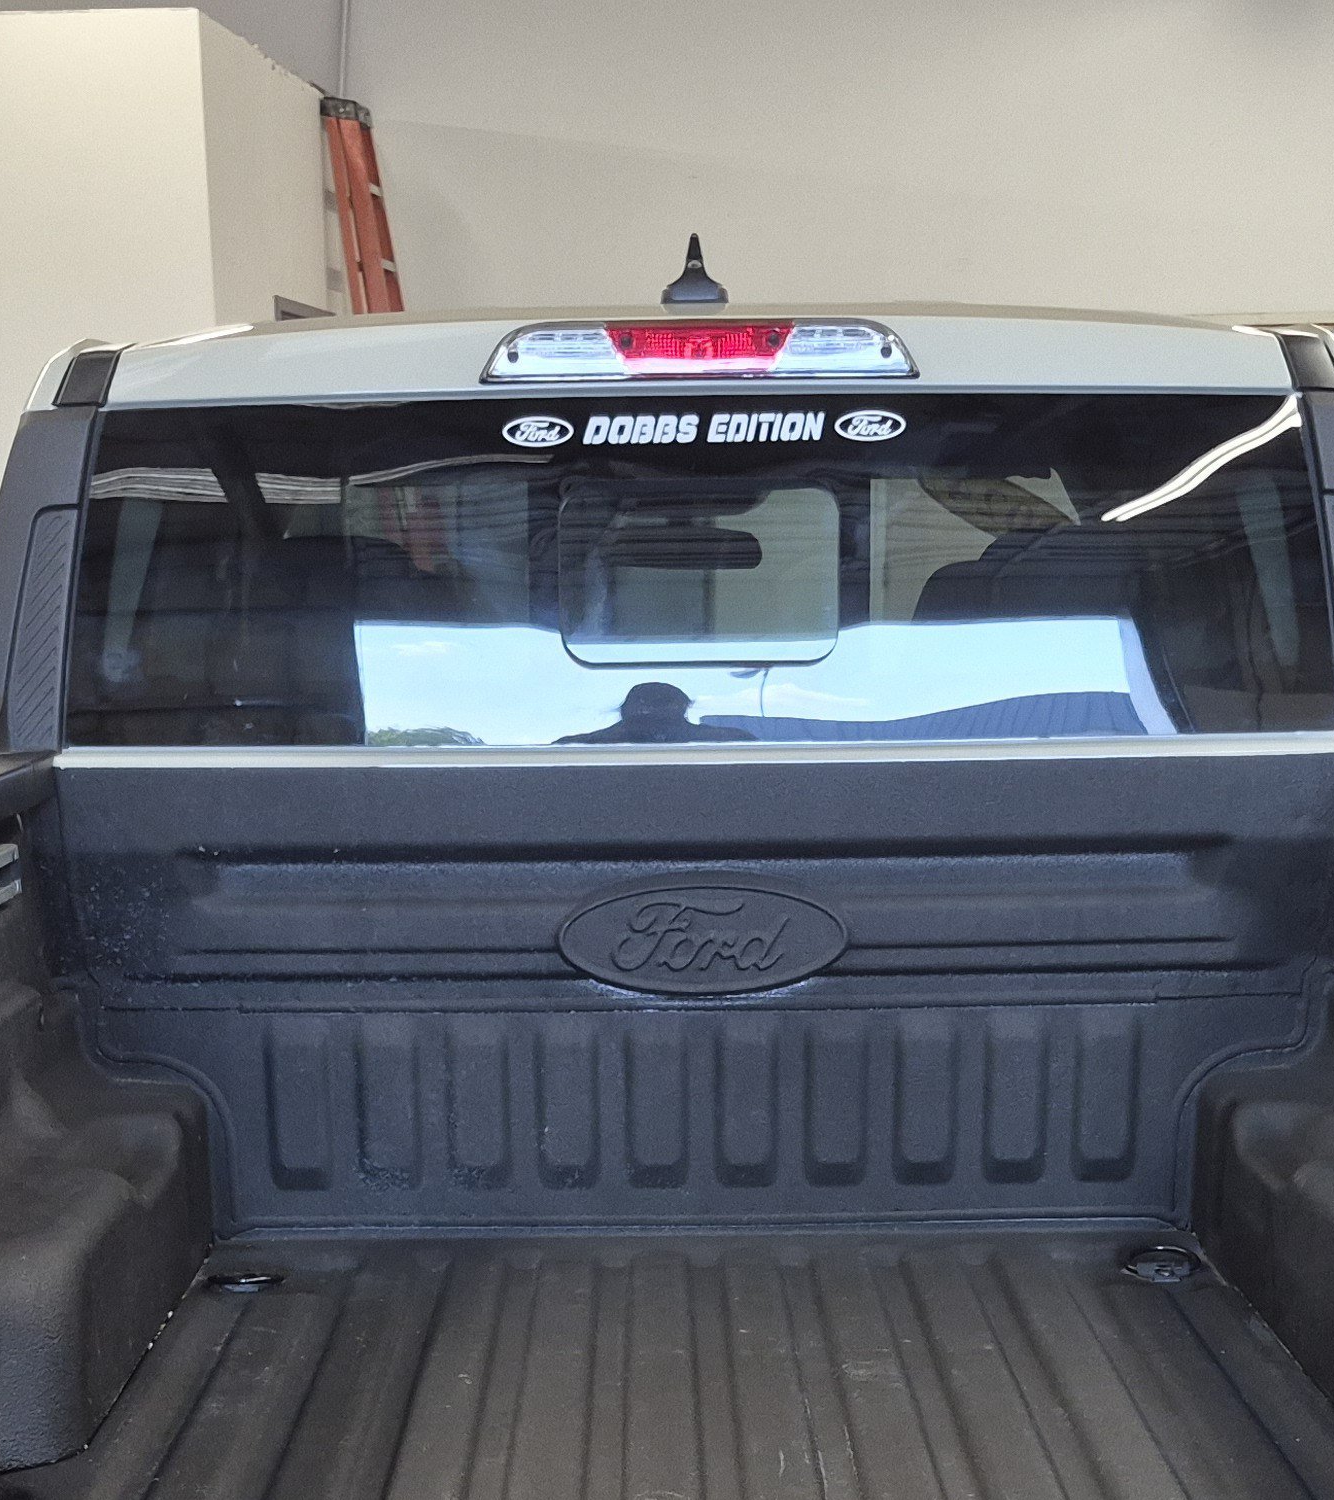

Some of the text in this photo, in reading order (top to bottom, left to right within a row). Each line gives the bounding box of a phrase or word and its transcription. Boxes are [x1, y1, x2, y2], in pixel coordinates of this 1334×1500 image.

[515, 421, 562, 442] Ford
[582, 411, 826, 445] DOBBS EDITION
[847, 415, 893, 437] Ford
[611, 902, 792, 973] Ford
